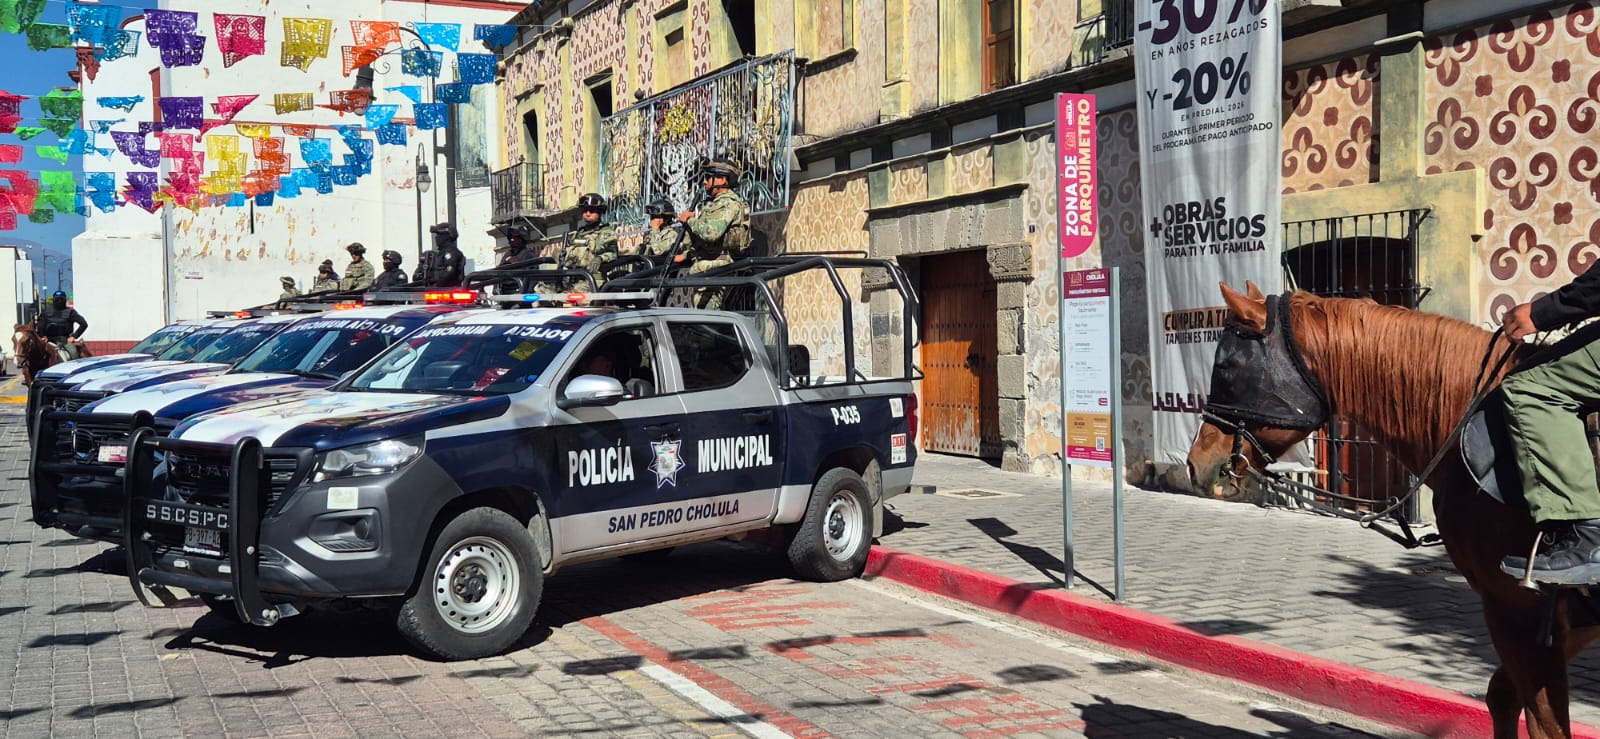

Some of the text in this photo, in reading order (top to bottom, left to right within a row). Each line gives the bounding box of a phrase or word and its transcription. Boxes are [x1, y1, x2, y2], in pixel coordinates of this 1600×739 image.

[1151, 18, 1268, 60] EN AÑOS REZAGADOS
[1146, 51, 1251, 111] Y -20%
[1152, 143, 1162, 153] DEL
[1198, 134, 1207, 143] DE
[1207, 131, 1228, 141] PAGO
[1161, 128, 1192, 140] DURANTE
[1199, 119, 1225, 132] PRIMER
[1077, 98, 1093, 237] PARQUÍMETRO
[1064, 155, 1079, 236] ZONA DE
[1163, 197, 1226, 225] OBRAS
[1164, 213, 1266, 247] SERVICIOS
[1165, 239, 1266, 258] PARA TI Y TU FAMILIA
[1206, 310, 1214, 328] A
[1194, 331, 1202, 344] ES
[830, 405, 861, 426] P-035
[568, 434, 773, 487] POLICÍA MUNICIPAL
[608, 499, 739, 533] SAN PEDRO CHOLULA
